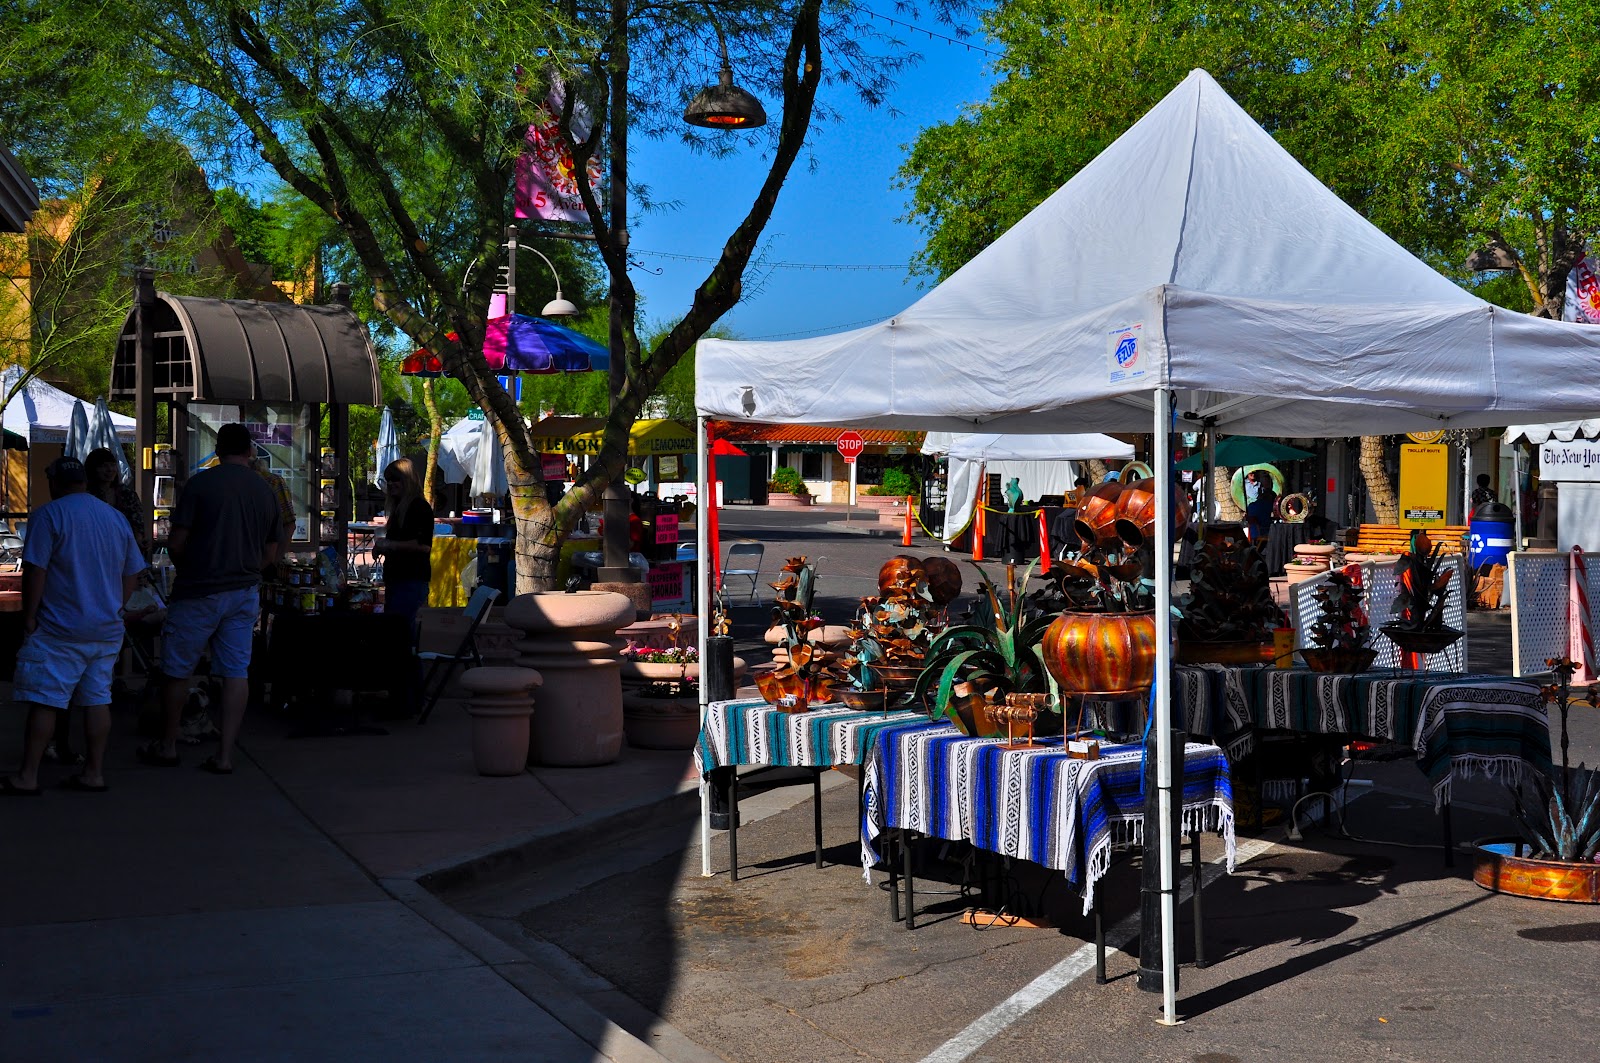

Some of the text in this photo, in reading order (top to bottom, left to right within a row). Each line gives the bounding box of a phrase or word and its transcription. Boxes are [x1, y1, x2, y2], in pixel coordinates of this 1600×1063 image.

[651, 438, 696, 451] LEMONADE
[839, 439, 862, 450] STOP
[1544, 448, 1560, 466] The
[1562, 448, 1581, 465] New
